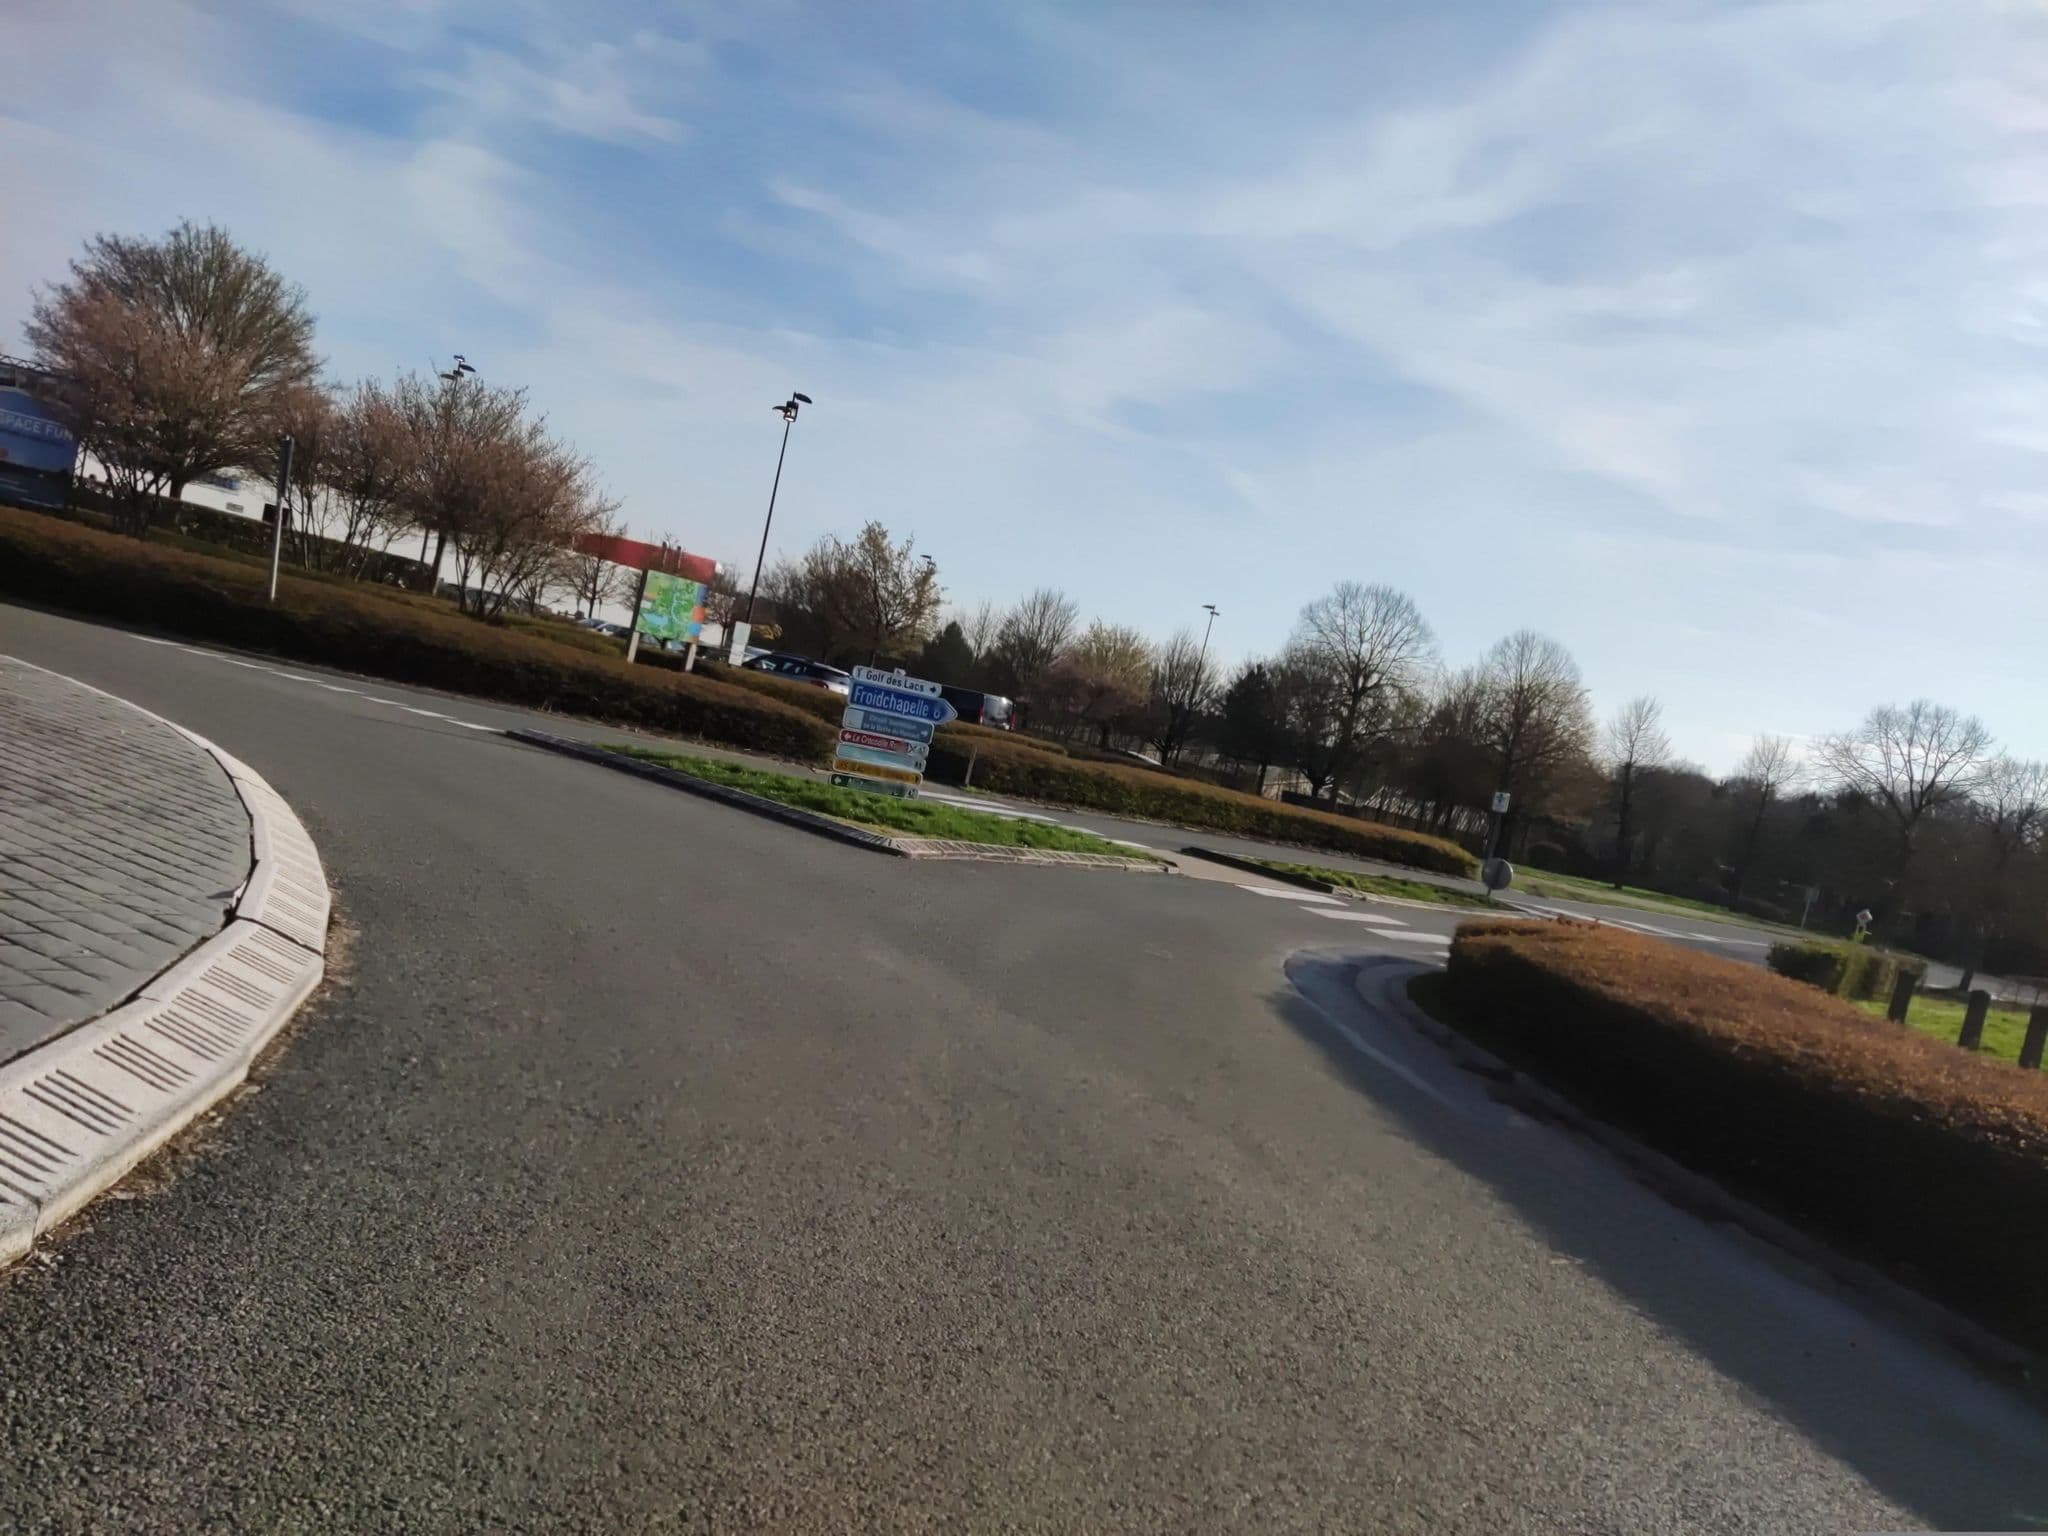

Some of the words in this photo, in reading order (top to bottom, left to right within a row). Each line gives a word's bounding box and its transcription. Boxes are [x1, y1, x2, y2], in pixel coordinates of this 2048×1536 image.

[46, 424, 74, 442] FUN
[866, 670, 885, 683] Golf
[886, 675, 902, 688] des
[903, 678, 925, 692] Lacs
[854, 685, 929, 717] Froidchapelle
